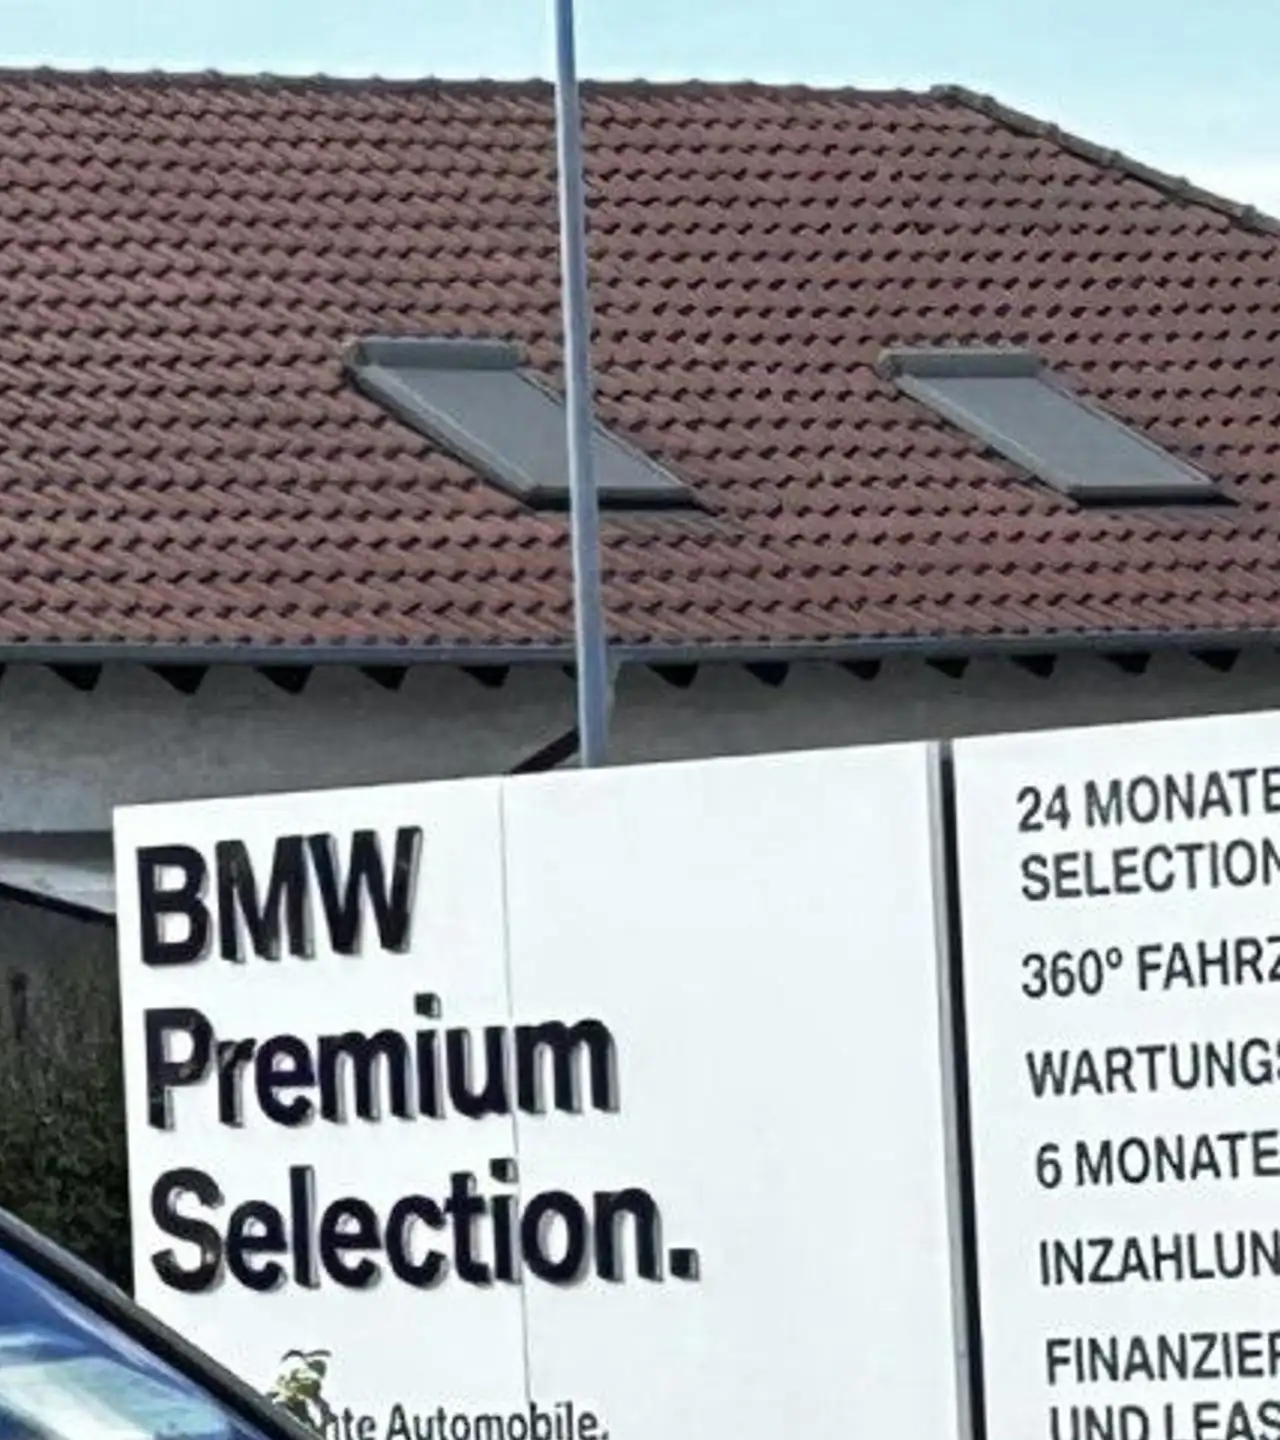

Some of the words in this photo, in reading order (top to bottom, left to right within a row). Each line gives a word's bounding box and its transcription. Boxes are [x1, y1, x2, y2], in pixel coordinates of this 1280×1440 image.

[1017, 784, 1071, 833] 24
[1085, 766, 1280, 827] MONATE
[136, 826, 424, 968] BMW
[144, 993, 620, 1131] Premium
[1025, 1038, 1280, 1097] WARTUNG
[1036, 1142, 1062, 1189] 6
[1075, 1130, 1280, 1187] MONATE
[151, 1158, 700, 1294] Selection.
[1040, 1229, 1280, 1286] INZAHLUN
